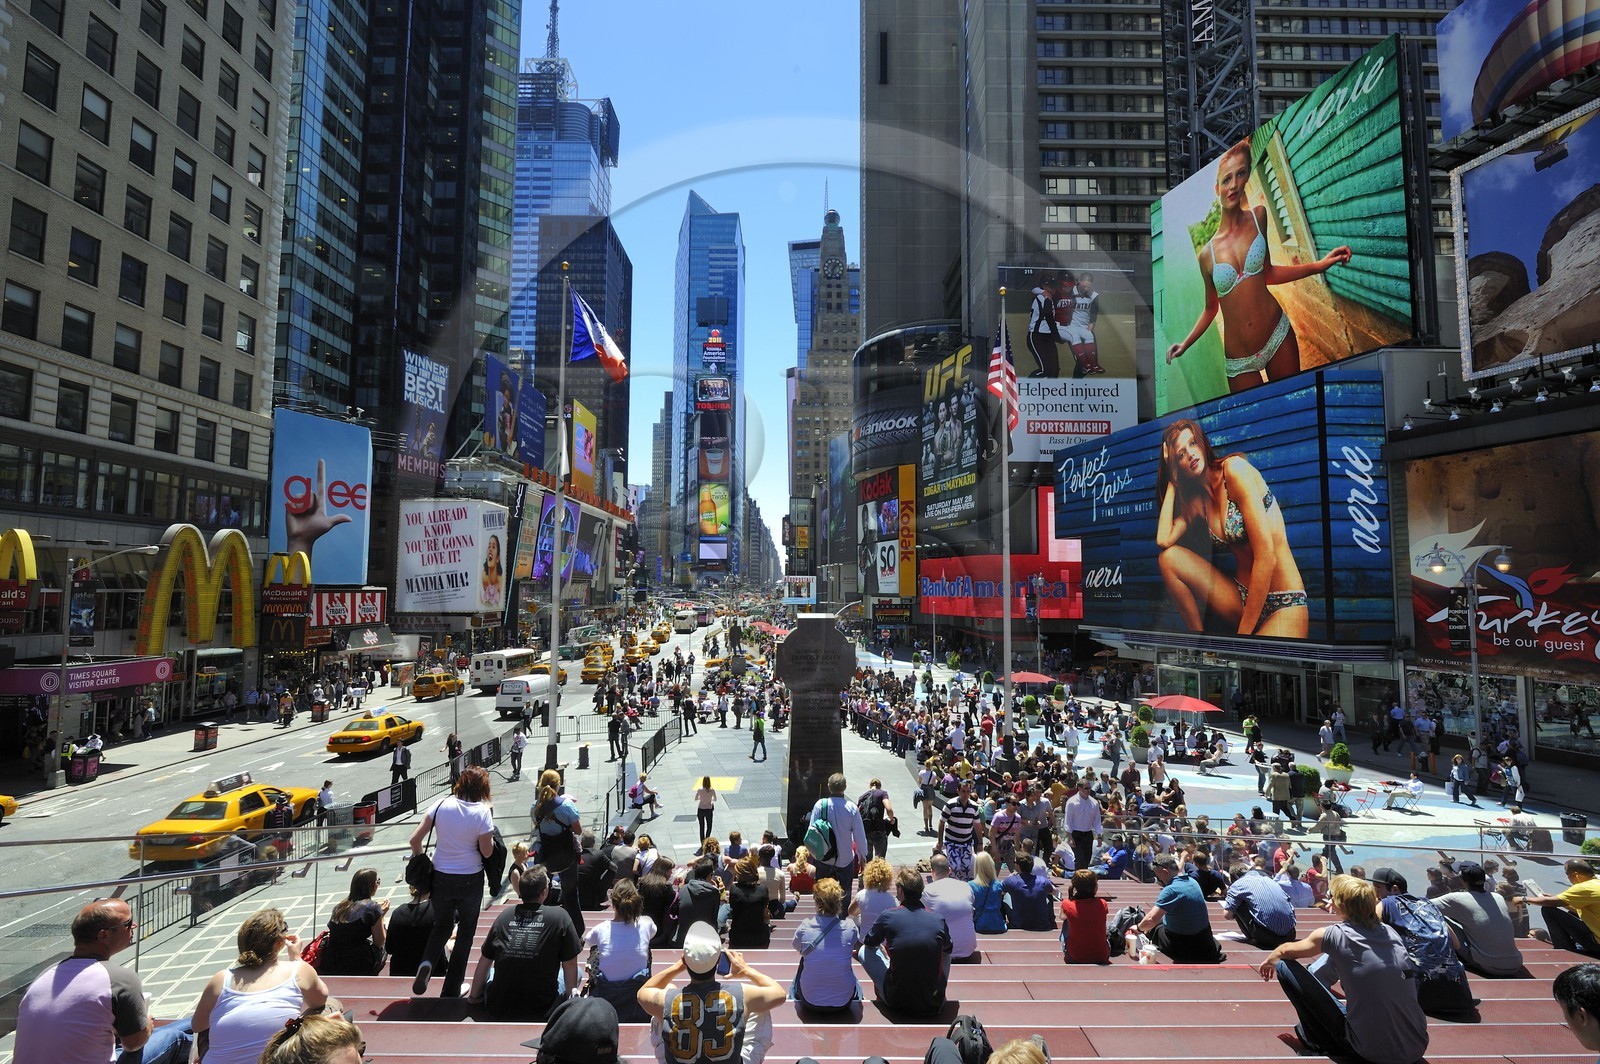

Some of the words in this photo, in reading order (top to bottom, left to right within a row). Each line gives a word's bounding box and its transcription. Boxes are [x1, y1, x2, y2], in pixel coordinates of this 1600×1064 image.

[1300, 55, 1385, 140] aerie
[404, 350, 448, 378] WINNER!
[924, 344, 972, 406] UFC
[404, 372, 446, 402] BEST
[1017, 382, 1067, 400] Helped
[1071, 383, 1120, 400] injured
[404, 390, 445, 414] MUSICAL
[1018, 402, 1084, 416] opponent
[1088, 400, 1118, 413] win.
[886, 428, 918, 436] emotion
[1029, 422, 1108, 433] SPORTSMANSHIP
[1049, 436, 1064, 444] Pass
[398, 454, 445, 478] MEMPHIS
[1058, 445, 1110, 504] Perfect
[860, 470, 892, 500] Kodak
[924, 484, 942, 497] EDGAR
[946, 473, 976, 490] MAYNARD
[1087, 468, 1133, 522] Pairs
[926, 500, 952, 512] SATURDAY
[952, 496, 963, 506] MAY
[1102, 508, 1114, 518] FIND
[1118, 506, 1130, 515] YOUR
[1134, 501, 1152, 514] MATCH
[1332, 446, 1382, 554] aerie
[405, 512, 424, 526] YOU
[427, 506, 468, 524] ALREADY
[424, 522, 453, 538] KNOW
[900, 500, 915, 562] Kodak
[405, 538, 439, 554] YOU'RE
[442, 534, 474, 550] GONNA
[422, 552, 446, 567] LOVE
[448, 550, 461, 564] IT!
[880, 544, 896, 570] SO
[406, 576, 444, 594] MAMMA
[447, 572, 469, 589] MIA!
[921, 576, 950, 597] Bank
[950, 576, 963, 597] of
[1494, 632, 1510, 646] be
[1514, 638, 1539, 648] our
[1544, 639, 1585, 653] guest
[68, 680, 94, 690] VISITOR
[96, 676, 120, 686] CENTER
[70, 671, 90, 680] TIMES
[91, 668, 116, 679] SQUARE
[668, 988, 738, 1062] 83
